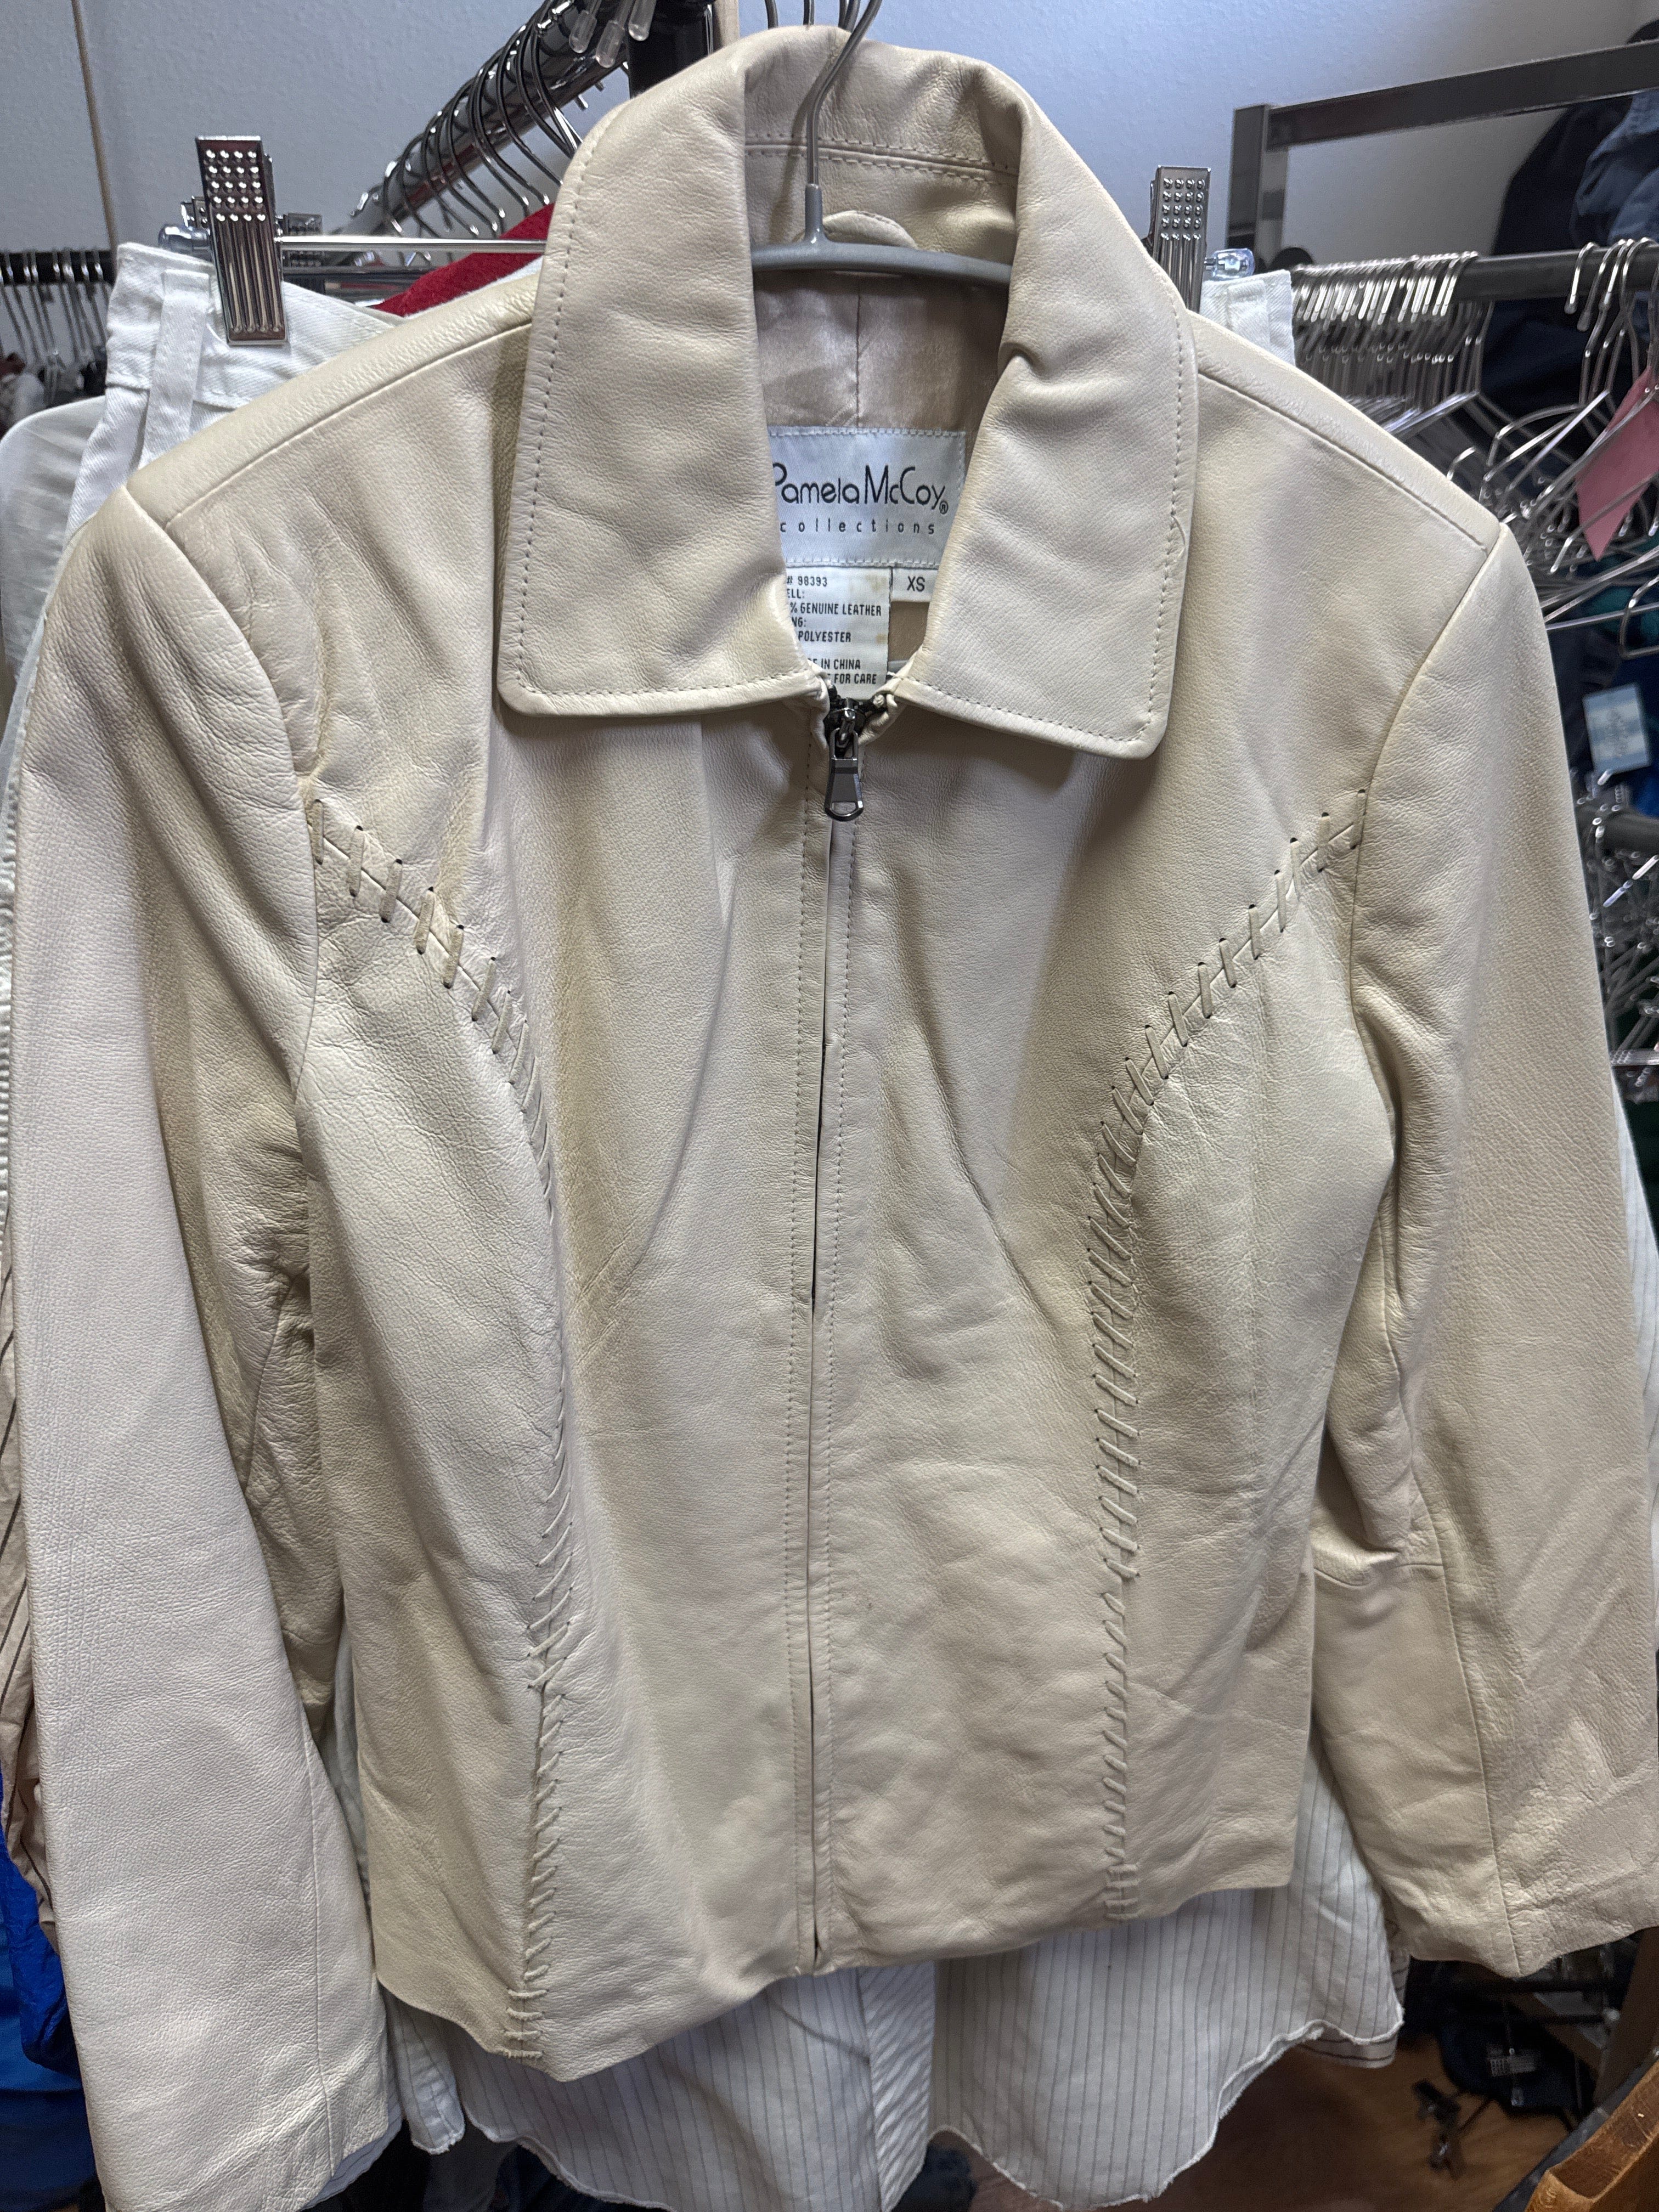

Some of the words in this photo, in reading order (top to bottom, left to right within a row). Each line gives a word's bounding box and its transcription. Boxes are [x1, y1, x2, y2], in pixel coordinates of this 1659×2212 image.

[772, 462, 860, 504] Pamela
[780, 517, 934, 534] collections
[798, 576, 828, 587] 98393
[907, 575, 926, 592] XS
[787, 588, 805, 599] ELL:
[800, 602, 839, 614] GENUINE
[842, 604, 882, 617] LEATHER
[798, 631, 851, 642] POLYESTER
[821, 658, 830, 669] IN
[833, 659, 861, 670] CHINA
[834, 673, 851, 684] FOR
[854, 674, 877, 684] CARE
